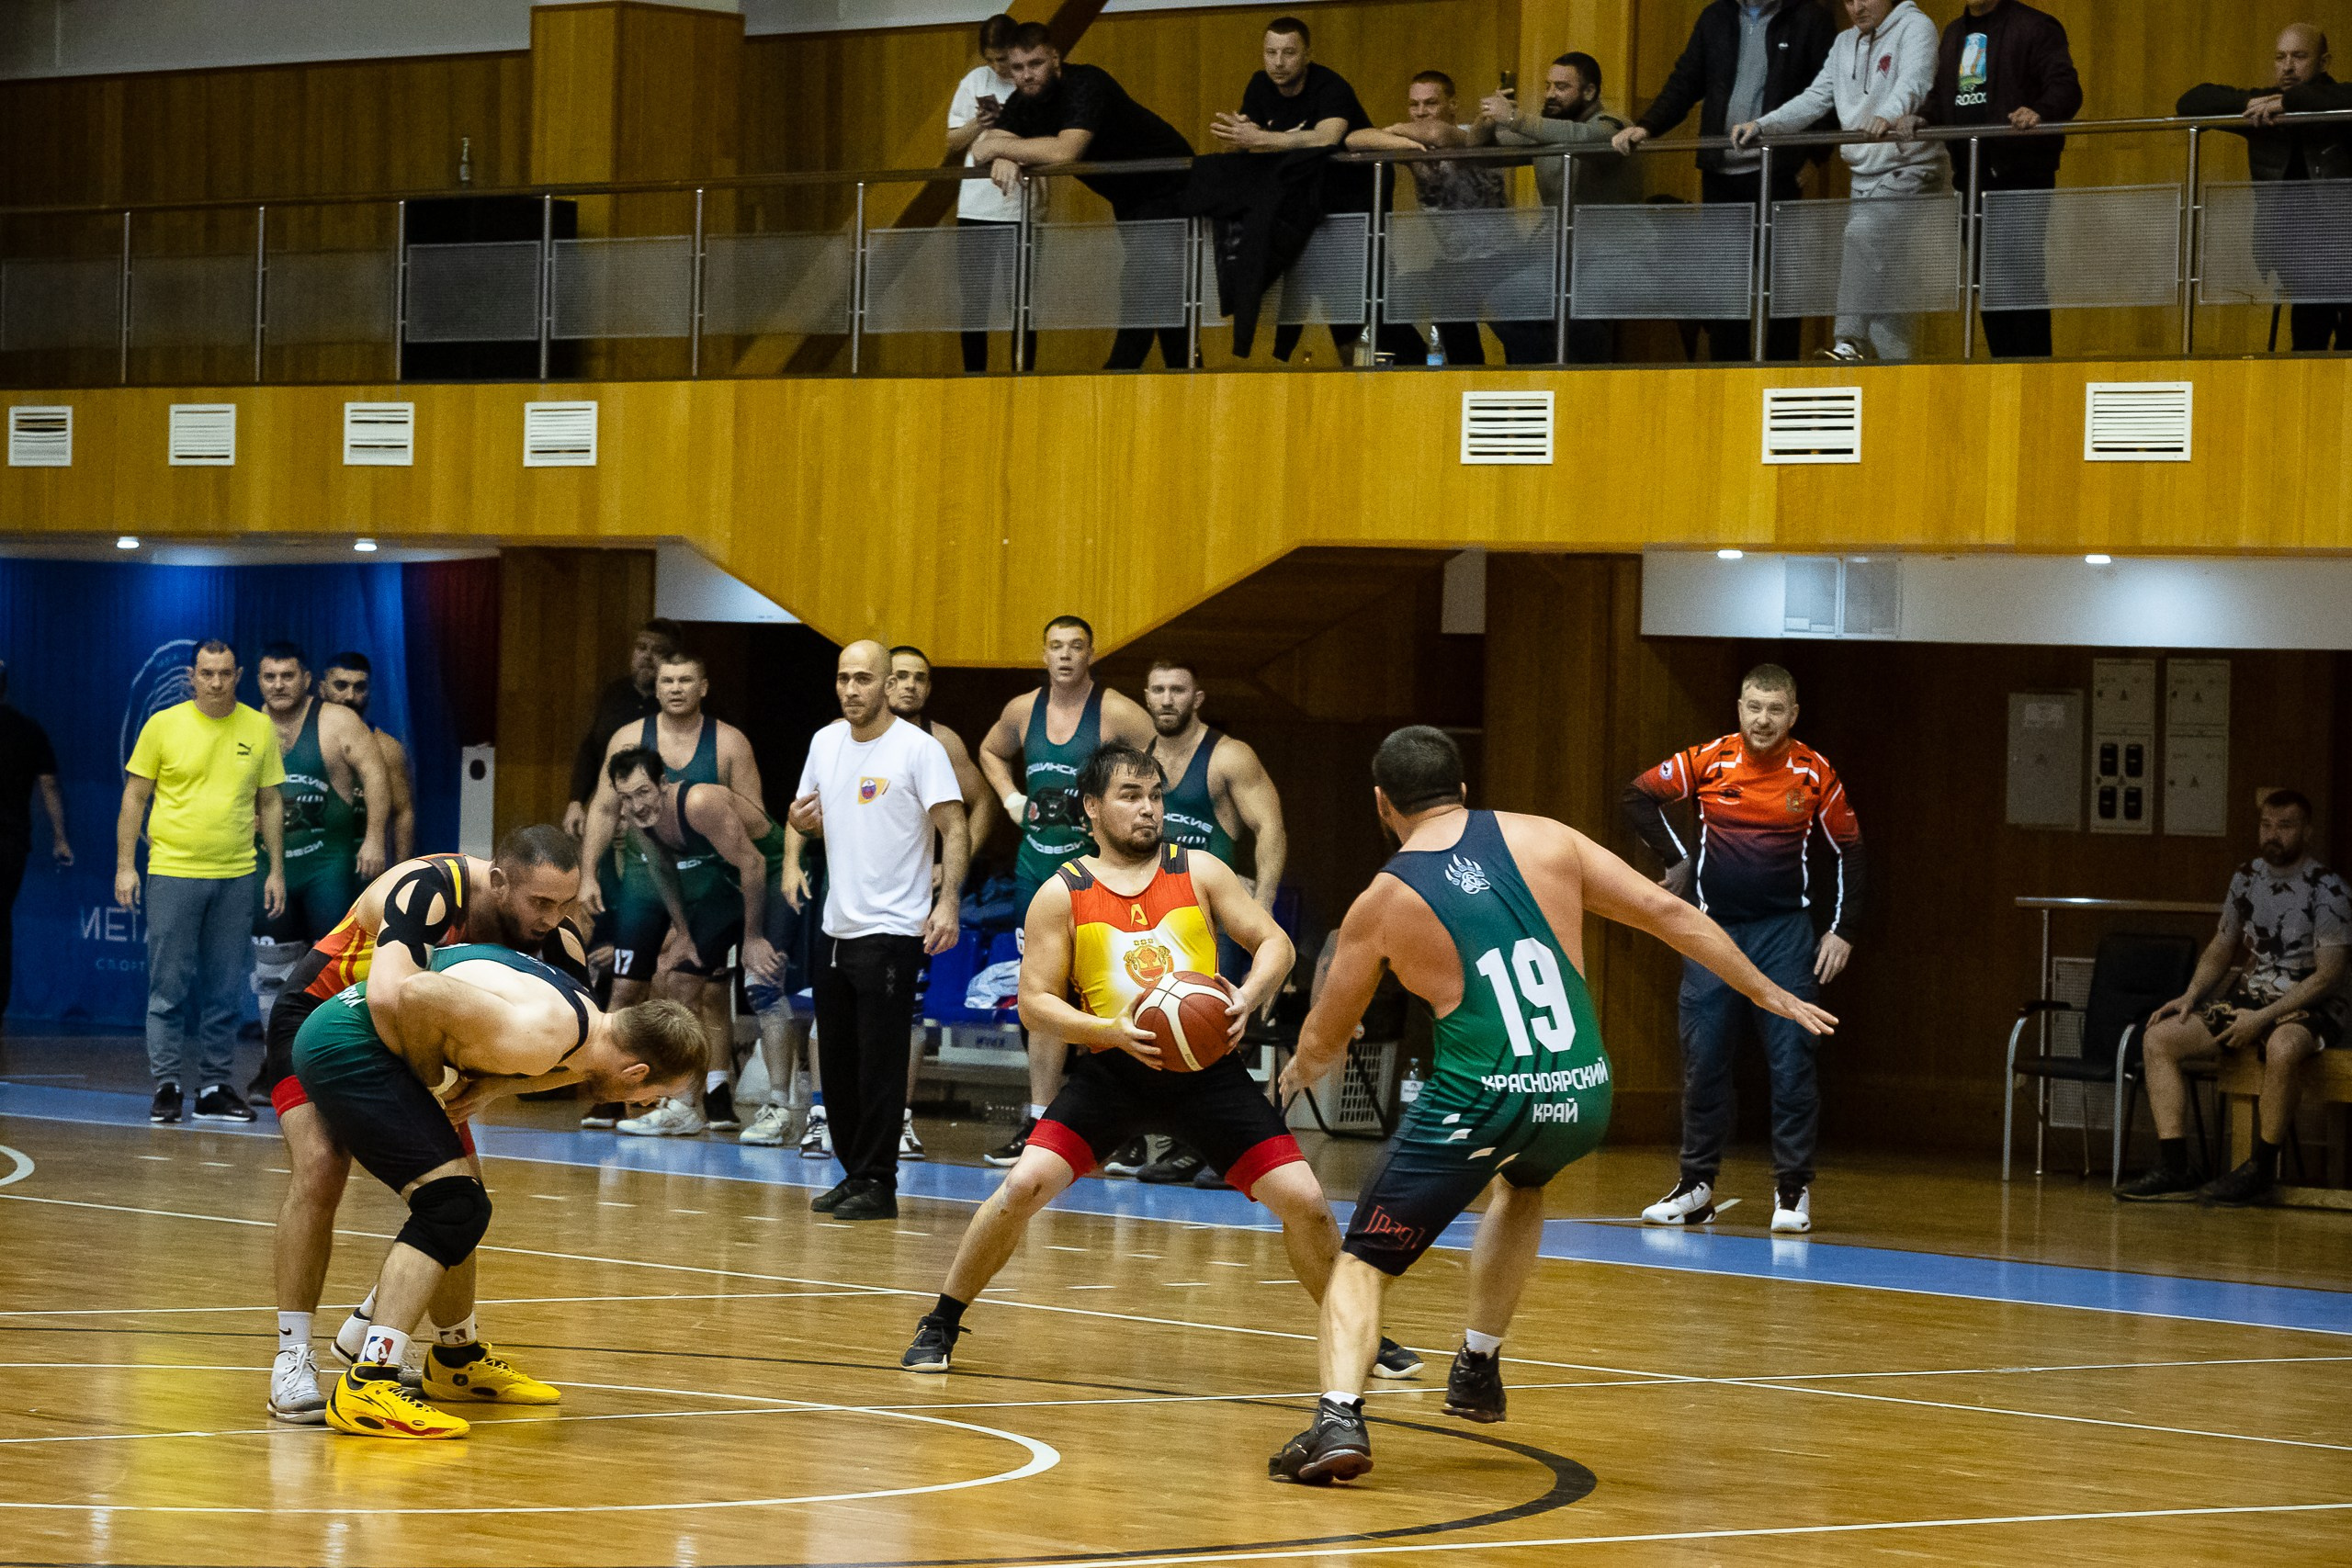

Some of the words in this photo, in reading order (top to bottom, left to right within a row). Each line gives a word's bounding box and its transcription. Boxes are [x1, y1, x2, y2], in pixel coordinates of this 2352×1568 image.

[614, 948, 635, 976] 17
[1475, 937, 1577, 1057] 19
[1480, 1056, 1609, 1093] КРАСНОЯРСКИЙ
[1532, 1098, 1578, 1123] КРАЙ
